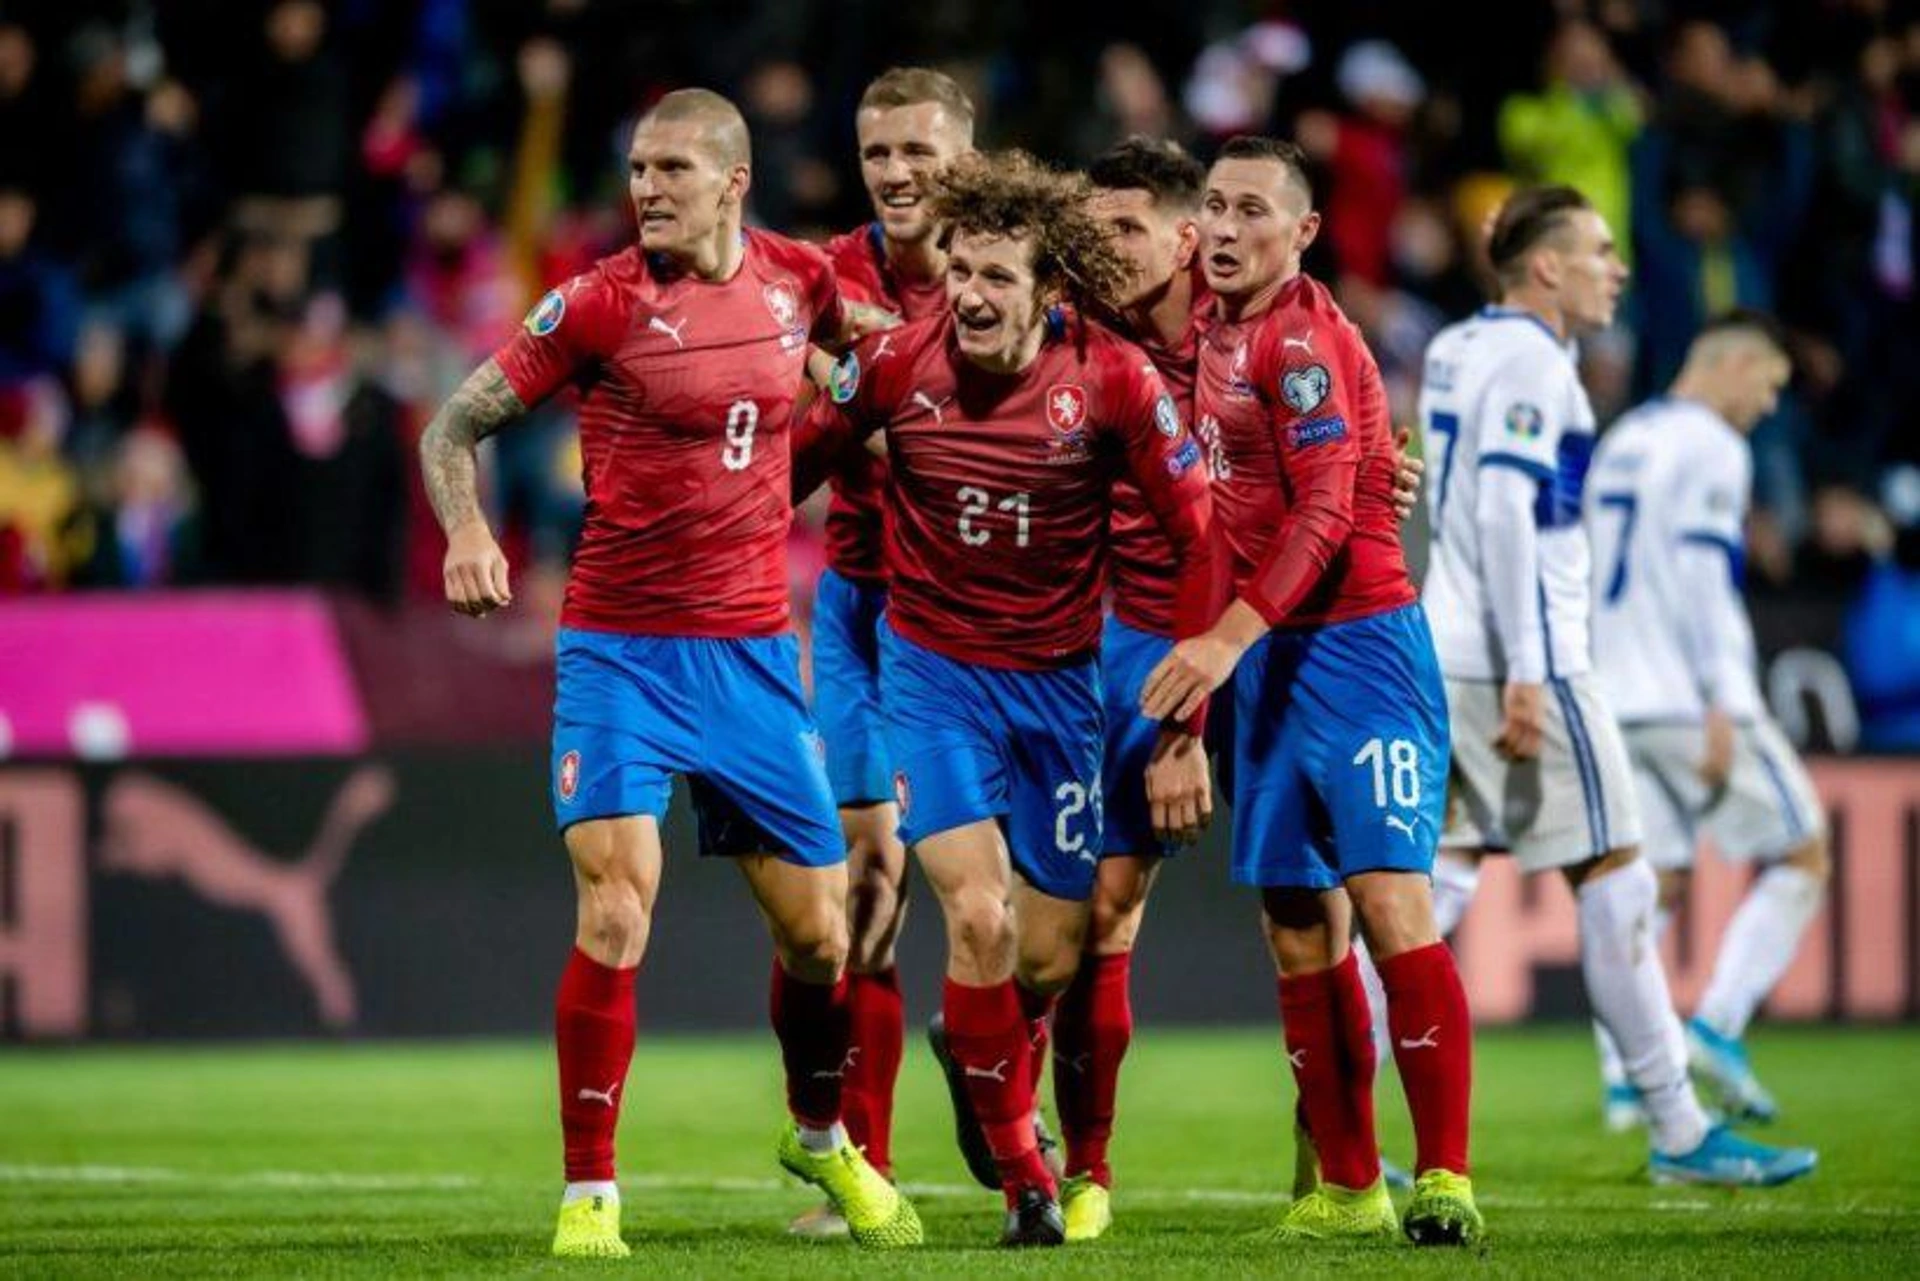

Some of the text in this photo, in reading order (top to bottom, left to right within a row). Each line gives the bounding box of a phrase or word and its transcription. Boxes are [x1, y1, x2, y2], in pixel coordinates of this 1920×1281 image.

[721, 399, 760, 471] 9
[956, 485, 1031, 549] 21
[1599, 493, 1637, 603] 7
[1352, 737, 1422, 808] 18
